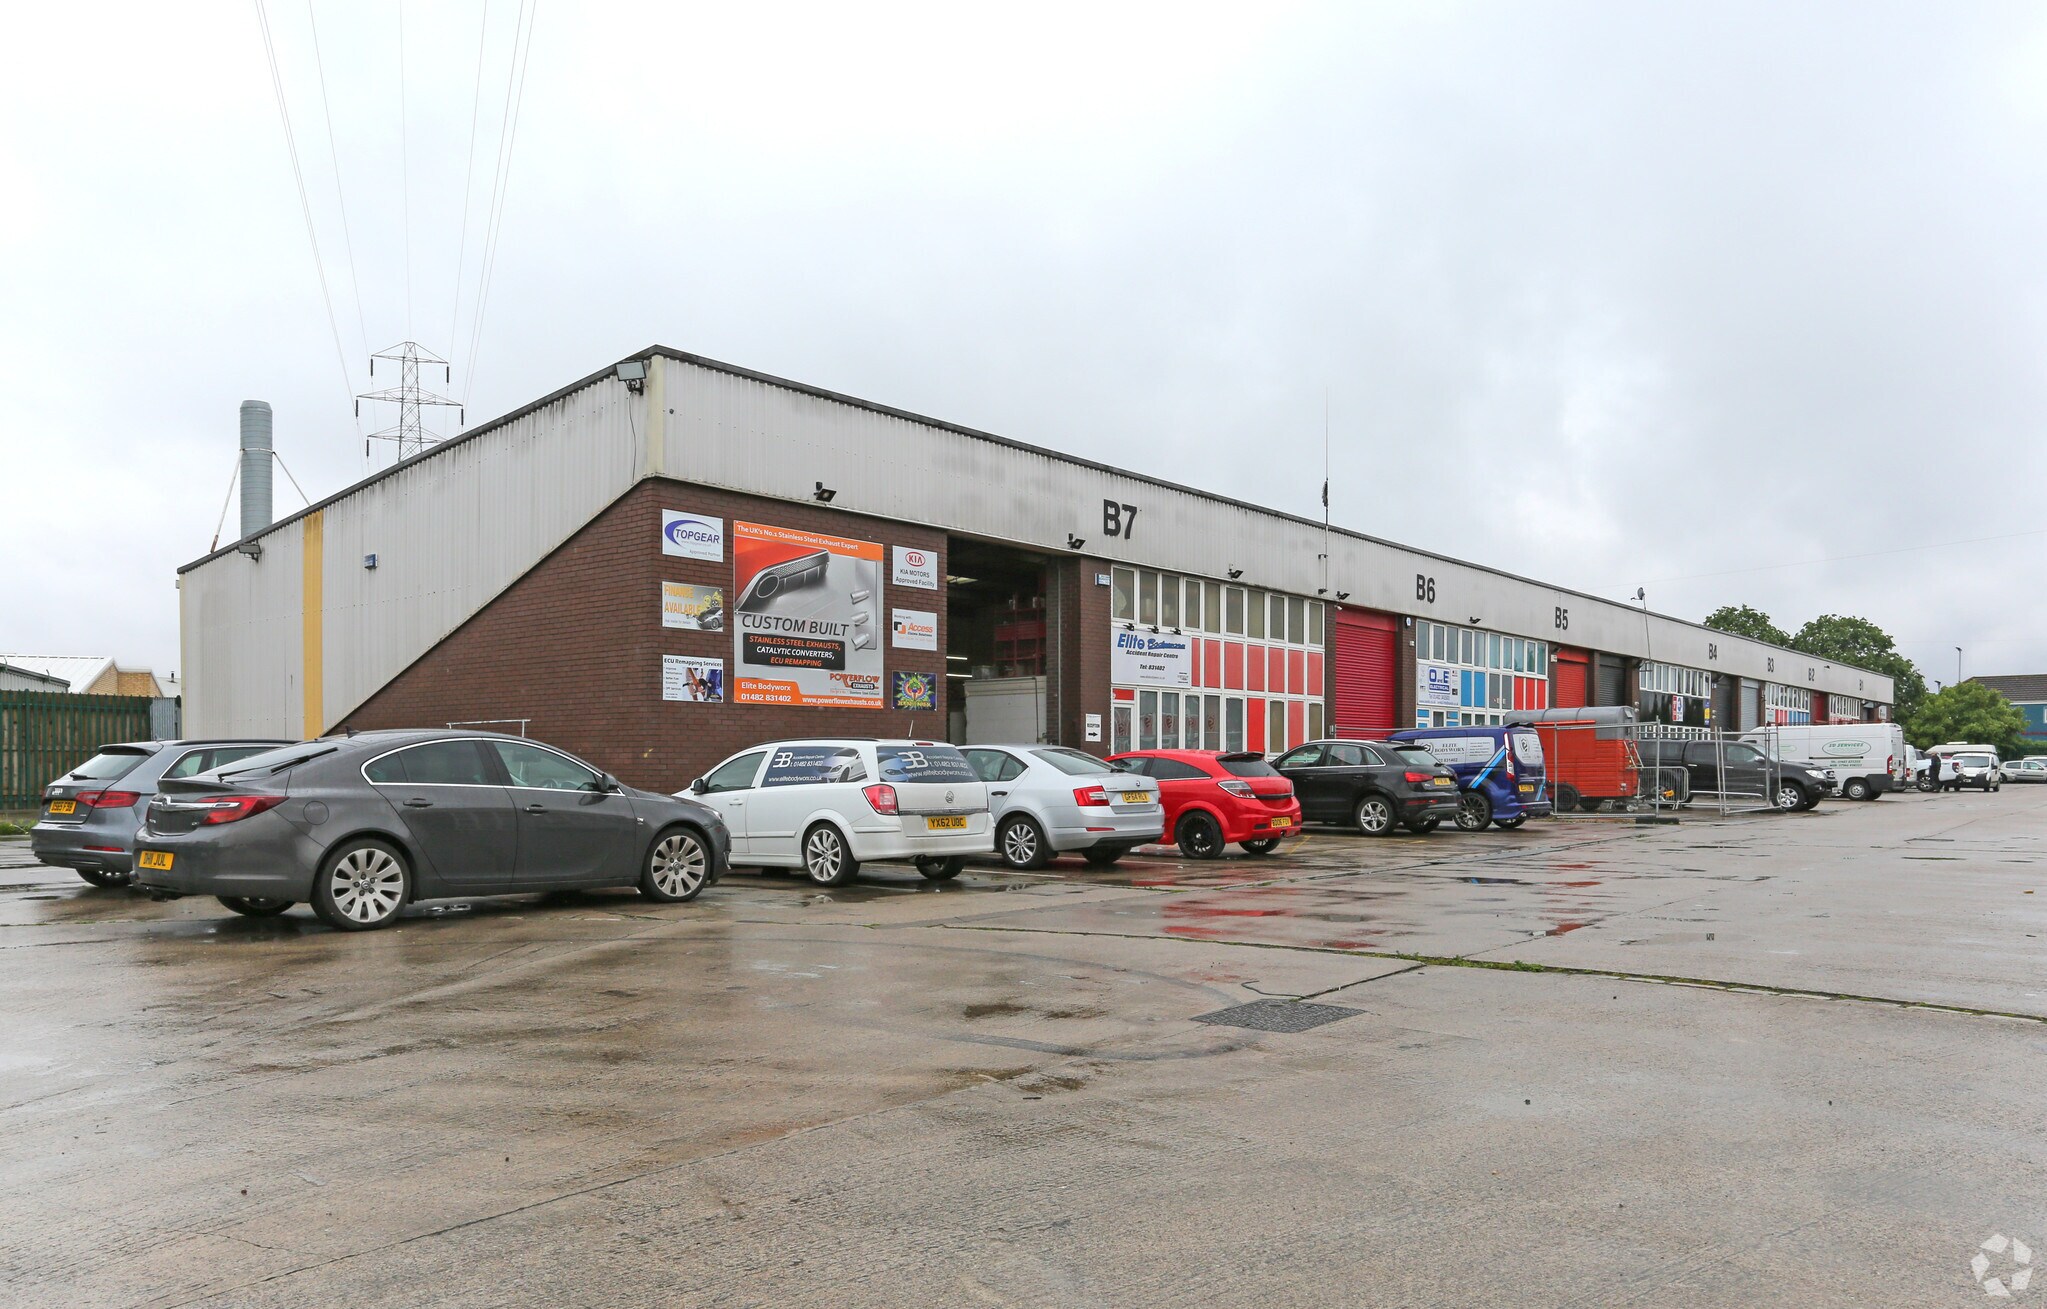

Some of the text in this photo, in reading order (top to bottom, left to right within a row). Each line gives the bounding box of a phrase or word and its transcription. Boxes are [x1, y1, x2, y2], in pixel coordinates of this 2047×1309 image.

[1103, 499, 1137, 540] B7
[676, 529, 720, 544] TOPGEAR
[738, 525, 749, 533] The
[749, 526, 762, 535] UK's
[778, 532, 803, 541] Stainless
[819, 538, 840, 547] Exhaust
[841, 542, 859, 550] Expert
[908, 554, 923, 564] KIA
[909, 570, 930, 578] MOTORS
[896, 577, 935, 588] Approved Facility
[1416, 574, 1436, 603] B6
[664, 585, 694, 598] FINANCE
[664, 601, 701, 617] AVAILABLE
[1555, 606, 1569, 630] B5
[742, 614, 849, 636] CUSTOM BUILT
[908, 623, 933, 633] Access
[749, 636, 841, 651] STAINLESS STEEL EXHAUSTS,
[1117, 633, 1145, 649] Elite
[757, 646, 835, 660] CATALYTIC CONVERTERS,
[1708, 643, 1718, 660] B4
[784, 658, 822, 667] REMAPPING
[1767, 657, 1775, 673] B3
[829, 673, 880, 685] POWERFLOW
[1443, 671, 1450, 683] E
[1808, 668, 1815, 681] B2
[758, 683, 791, 692] Bodyworx
[801, 697, 881, 706] www.powerflowexhausts.co.uk
[930, 817, 950, 828] YX62
